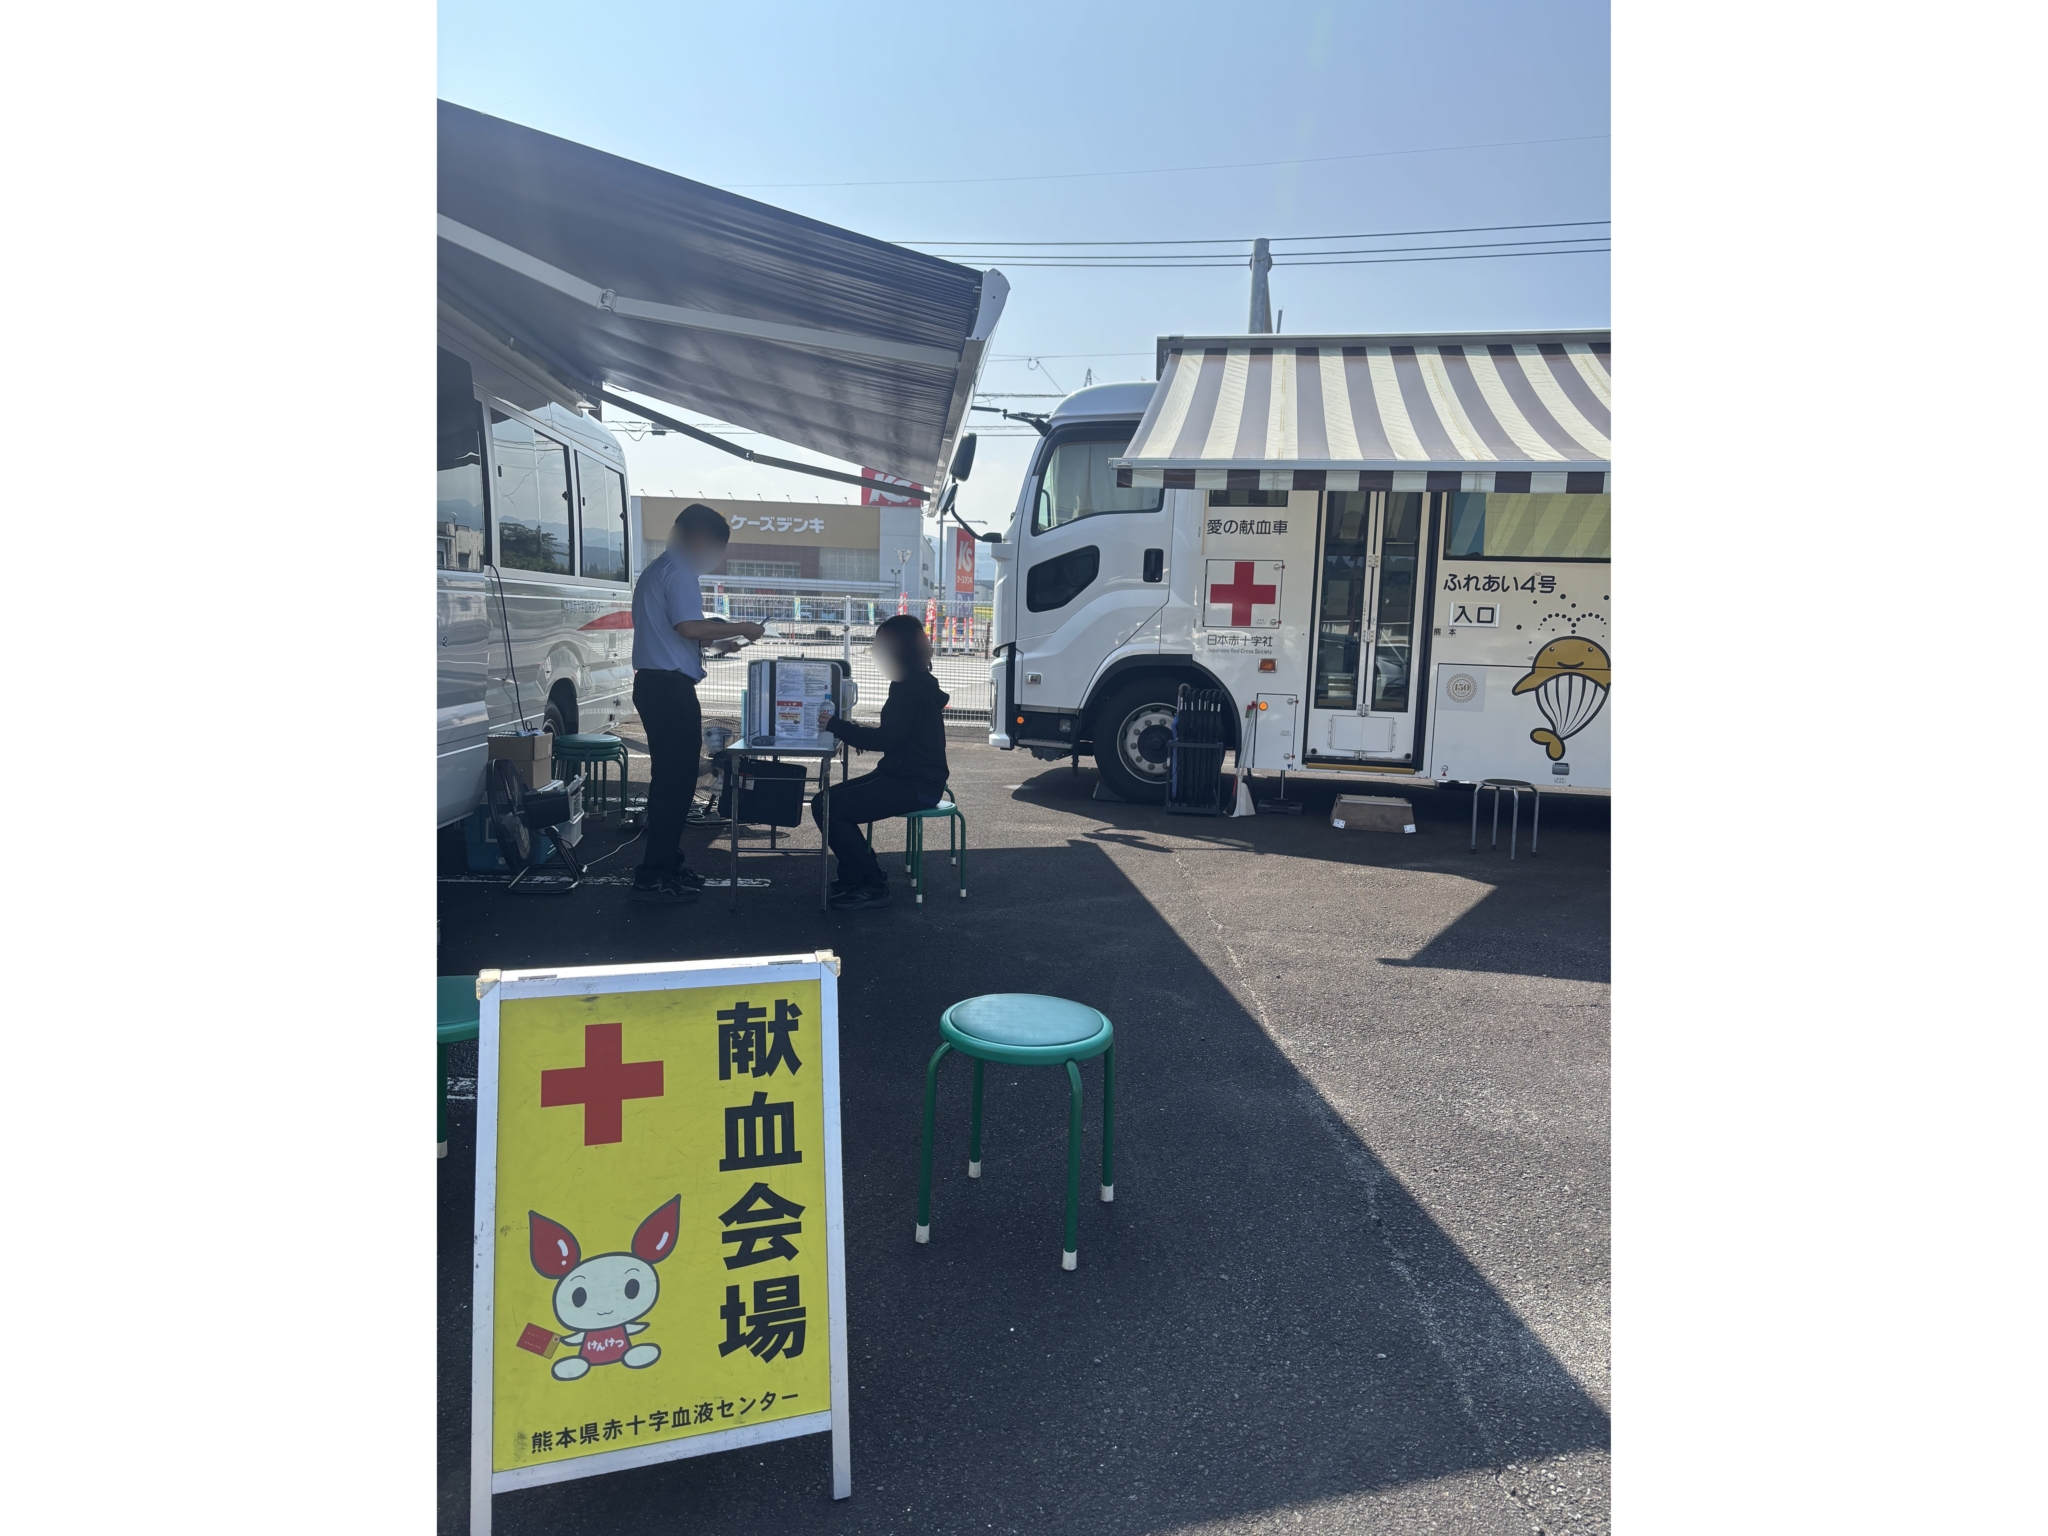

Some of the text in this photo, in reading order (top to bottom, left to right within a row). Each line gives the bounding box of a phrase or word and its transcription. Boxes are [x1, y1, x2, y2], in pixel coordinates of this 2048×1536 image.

[730, 514, 825, 534] ケーズデンキ
[1206, 519, 1289, 536] 愛の献血車
[1443, 573, 1557, 594] ふれあい4号
[1454, 605, 1496, 625] 入口
[1207, 634, 1273, 648] 日本赤十字社
[1454, 683, 1470, 692] 150
[716, 998, 808, 1364] 献血会場
[587, 1336, 625, 1352] けんけつ
[530, 1391, 799, 1455] 熊本県赤十字血液センター
